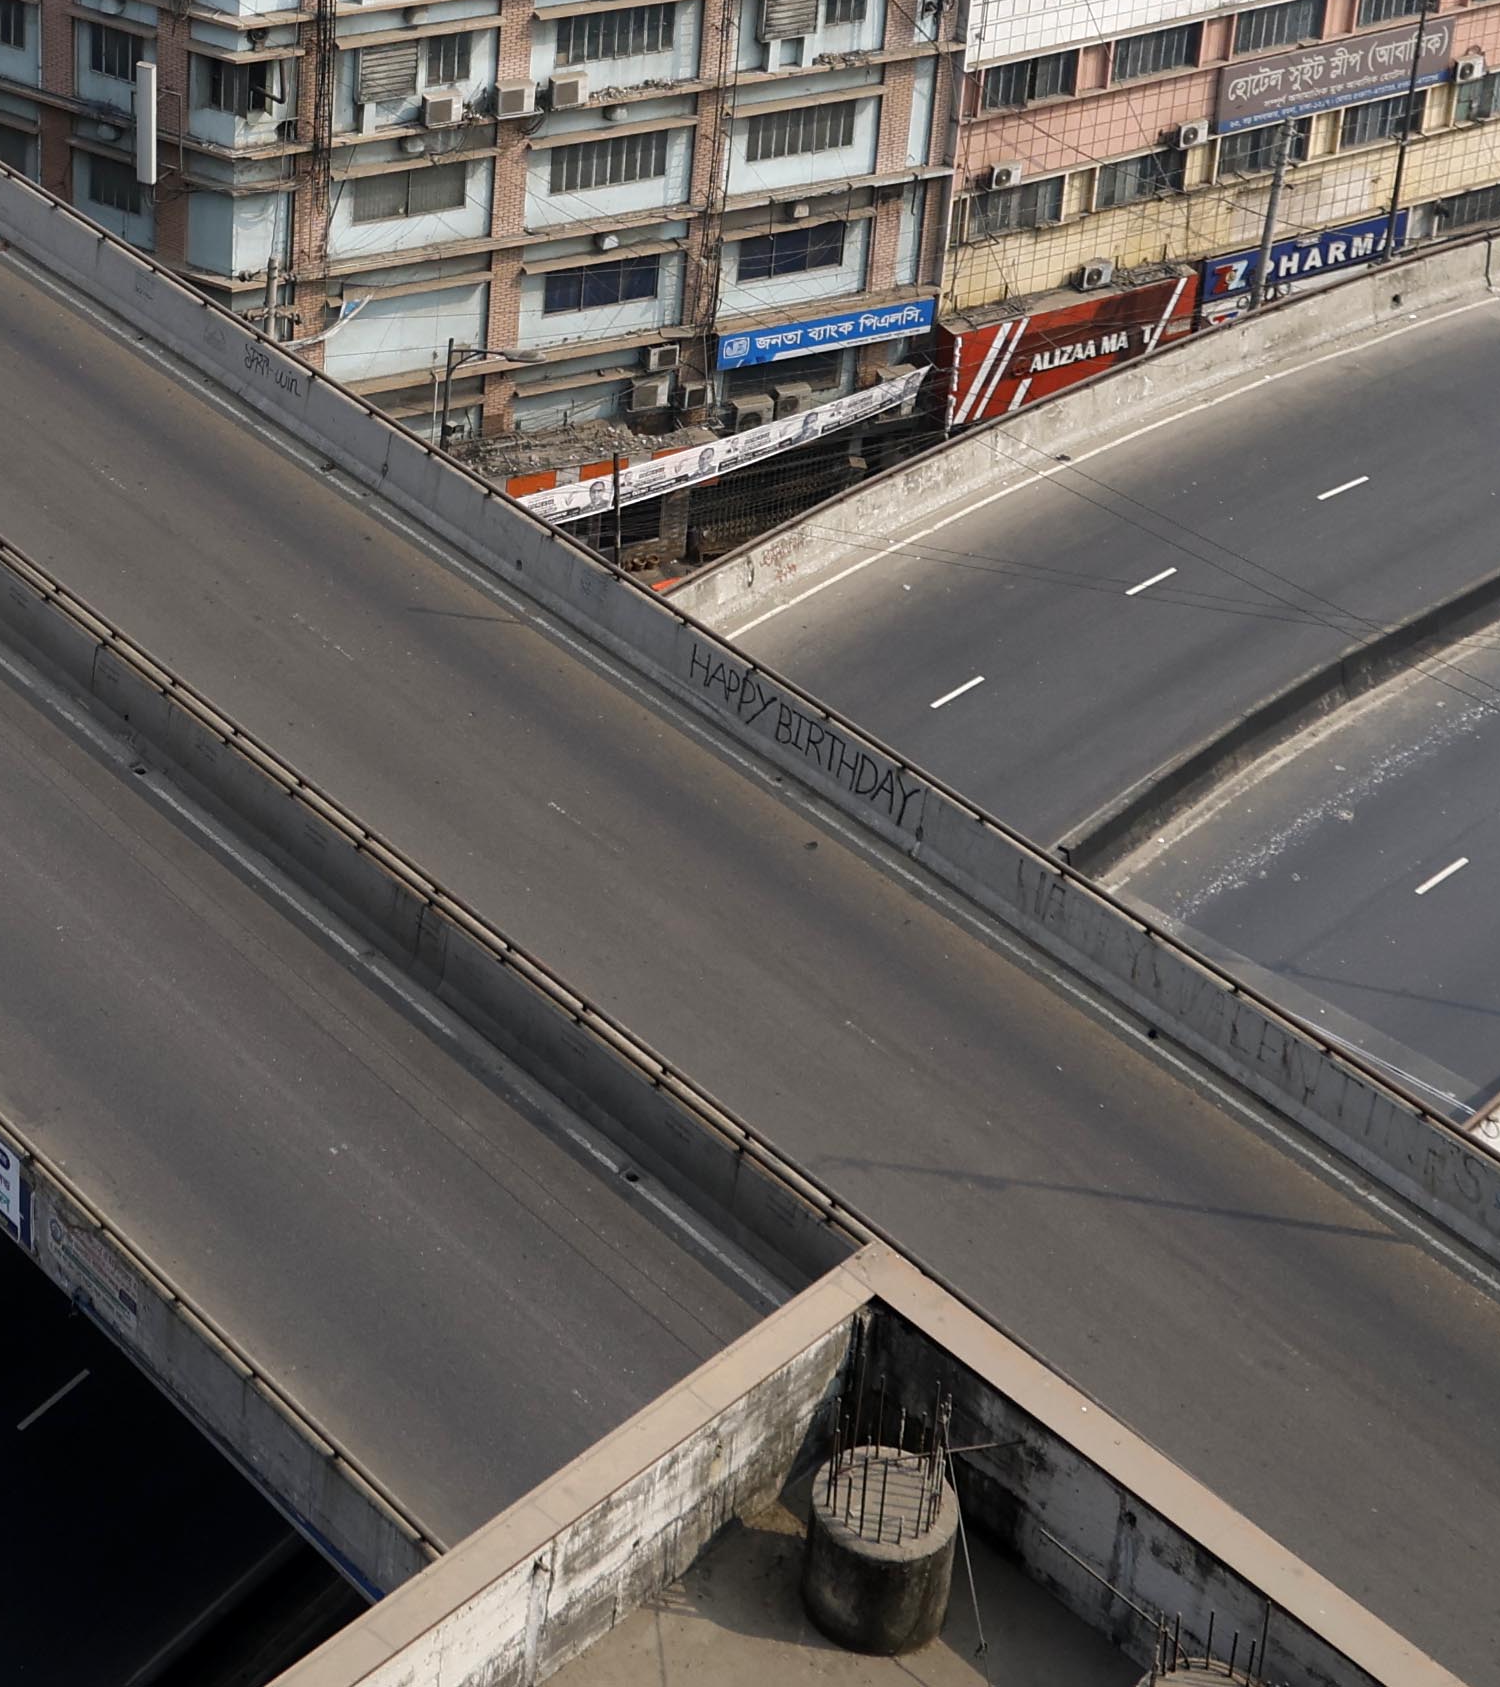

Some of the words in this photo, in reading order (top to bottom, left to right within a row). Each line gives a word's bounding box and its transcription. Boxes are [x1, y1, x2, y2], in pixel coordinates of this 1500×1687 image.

[1228, 69, 1284, 103] হোটেল
[1288, 54, 1327, 92] সুইট
[755, 329, 803, 351] জনতা
[807, 319, 855, 342] ব্যাংক
[858, 305, 924, 333] পিএলসি.
[1029, 339, 1096, 373] ALIZAA
[690, 643, 777, 725] HAPPY
